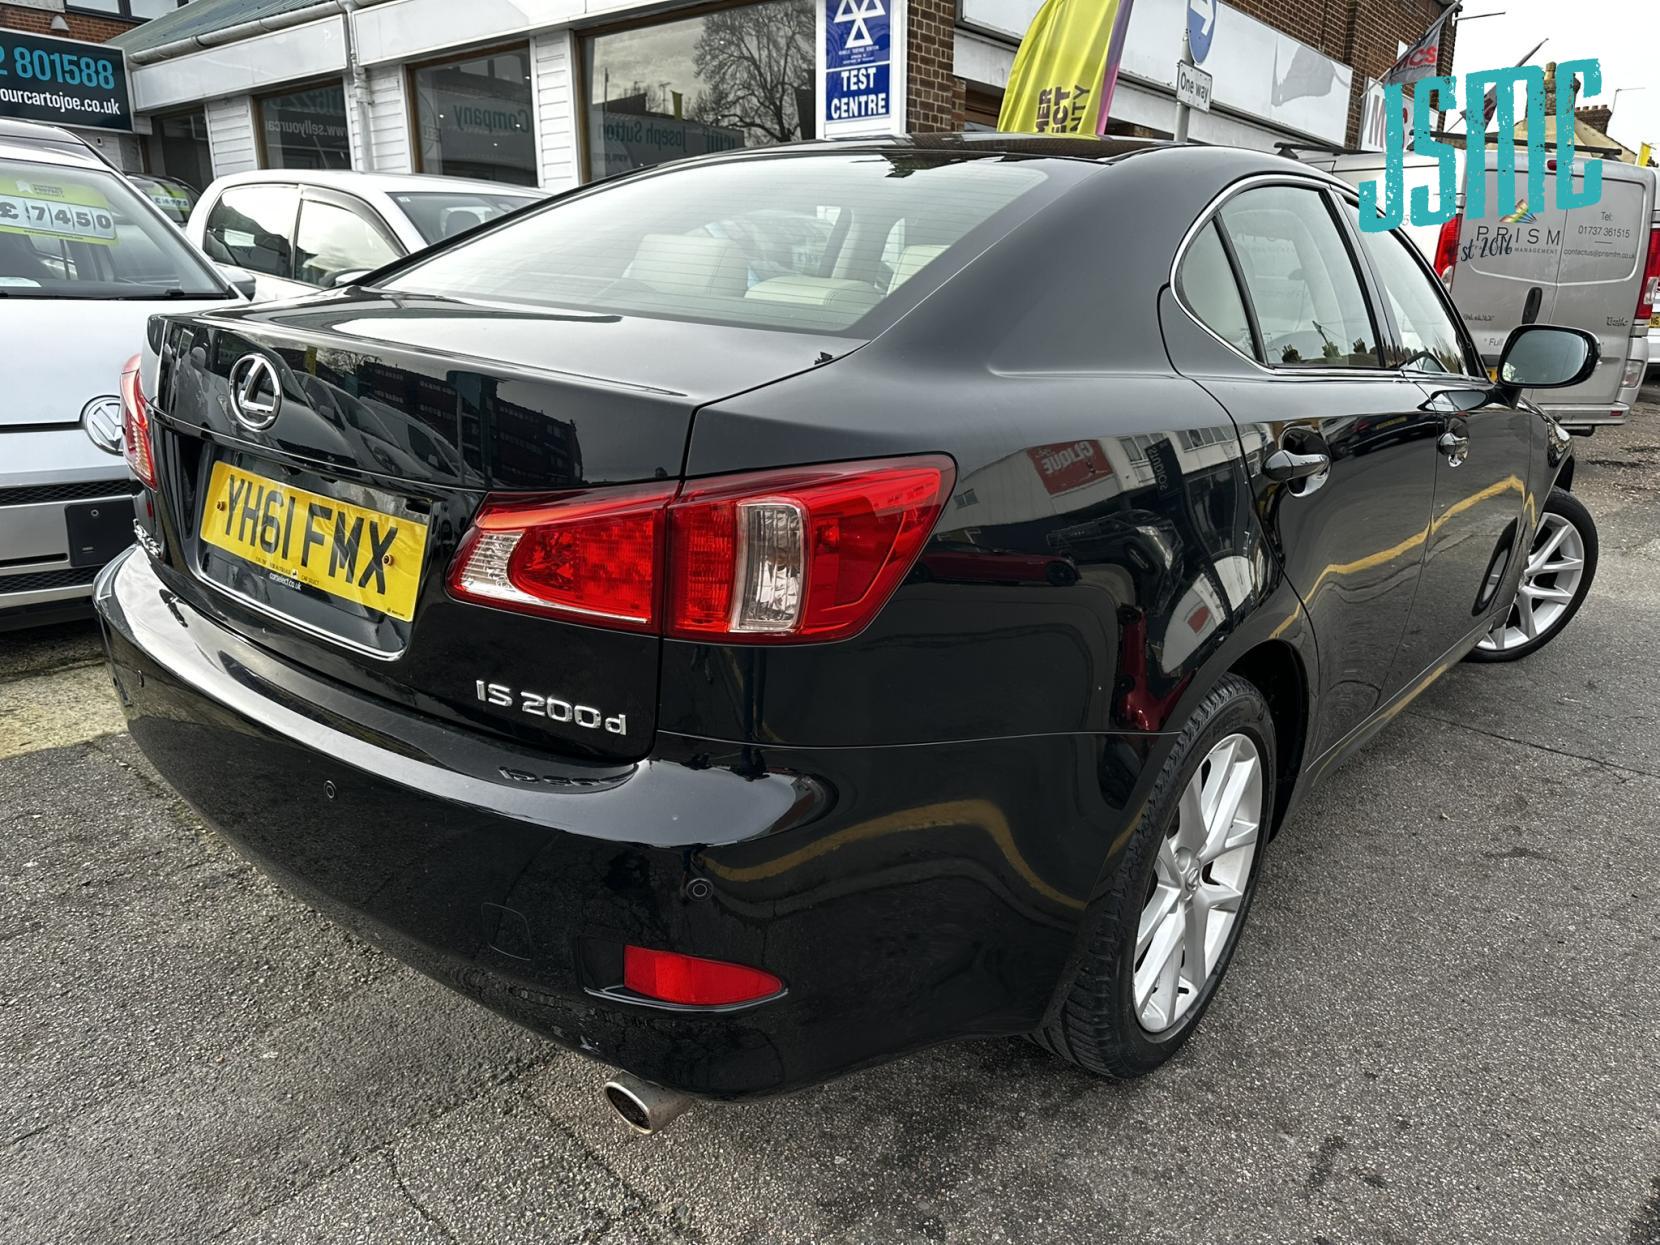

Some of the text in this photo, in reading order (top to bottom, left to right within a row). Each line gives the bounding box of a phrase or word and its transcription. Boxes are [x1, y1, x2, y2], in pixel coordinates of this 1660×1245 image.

[13, 46, 116, 90] 801588
[841, 67, 877, 92] TEST
[1181, 72, 1209, 104] One way
[831, 93, 886, 119] CENTRE
[1476, 225, 1561, 247] PRISM
[1578, 225, 1631, 239] 01737 361515
[1514, 246, 1559, 255] MANAGEMENT
[225, 473, 297, 561] YH61
[300, 502, 398, 595] FMX
[476, 679, 627, 736] IS 200d
